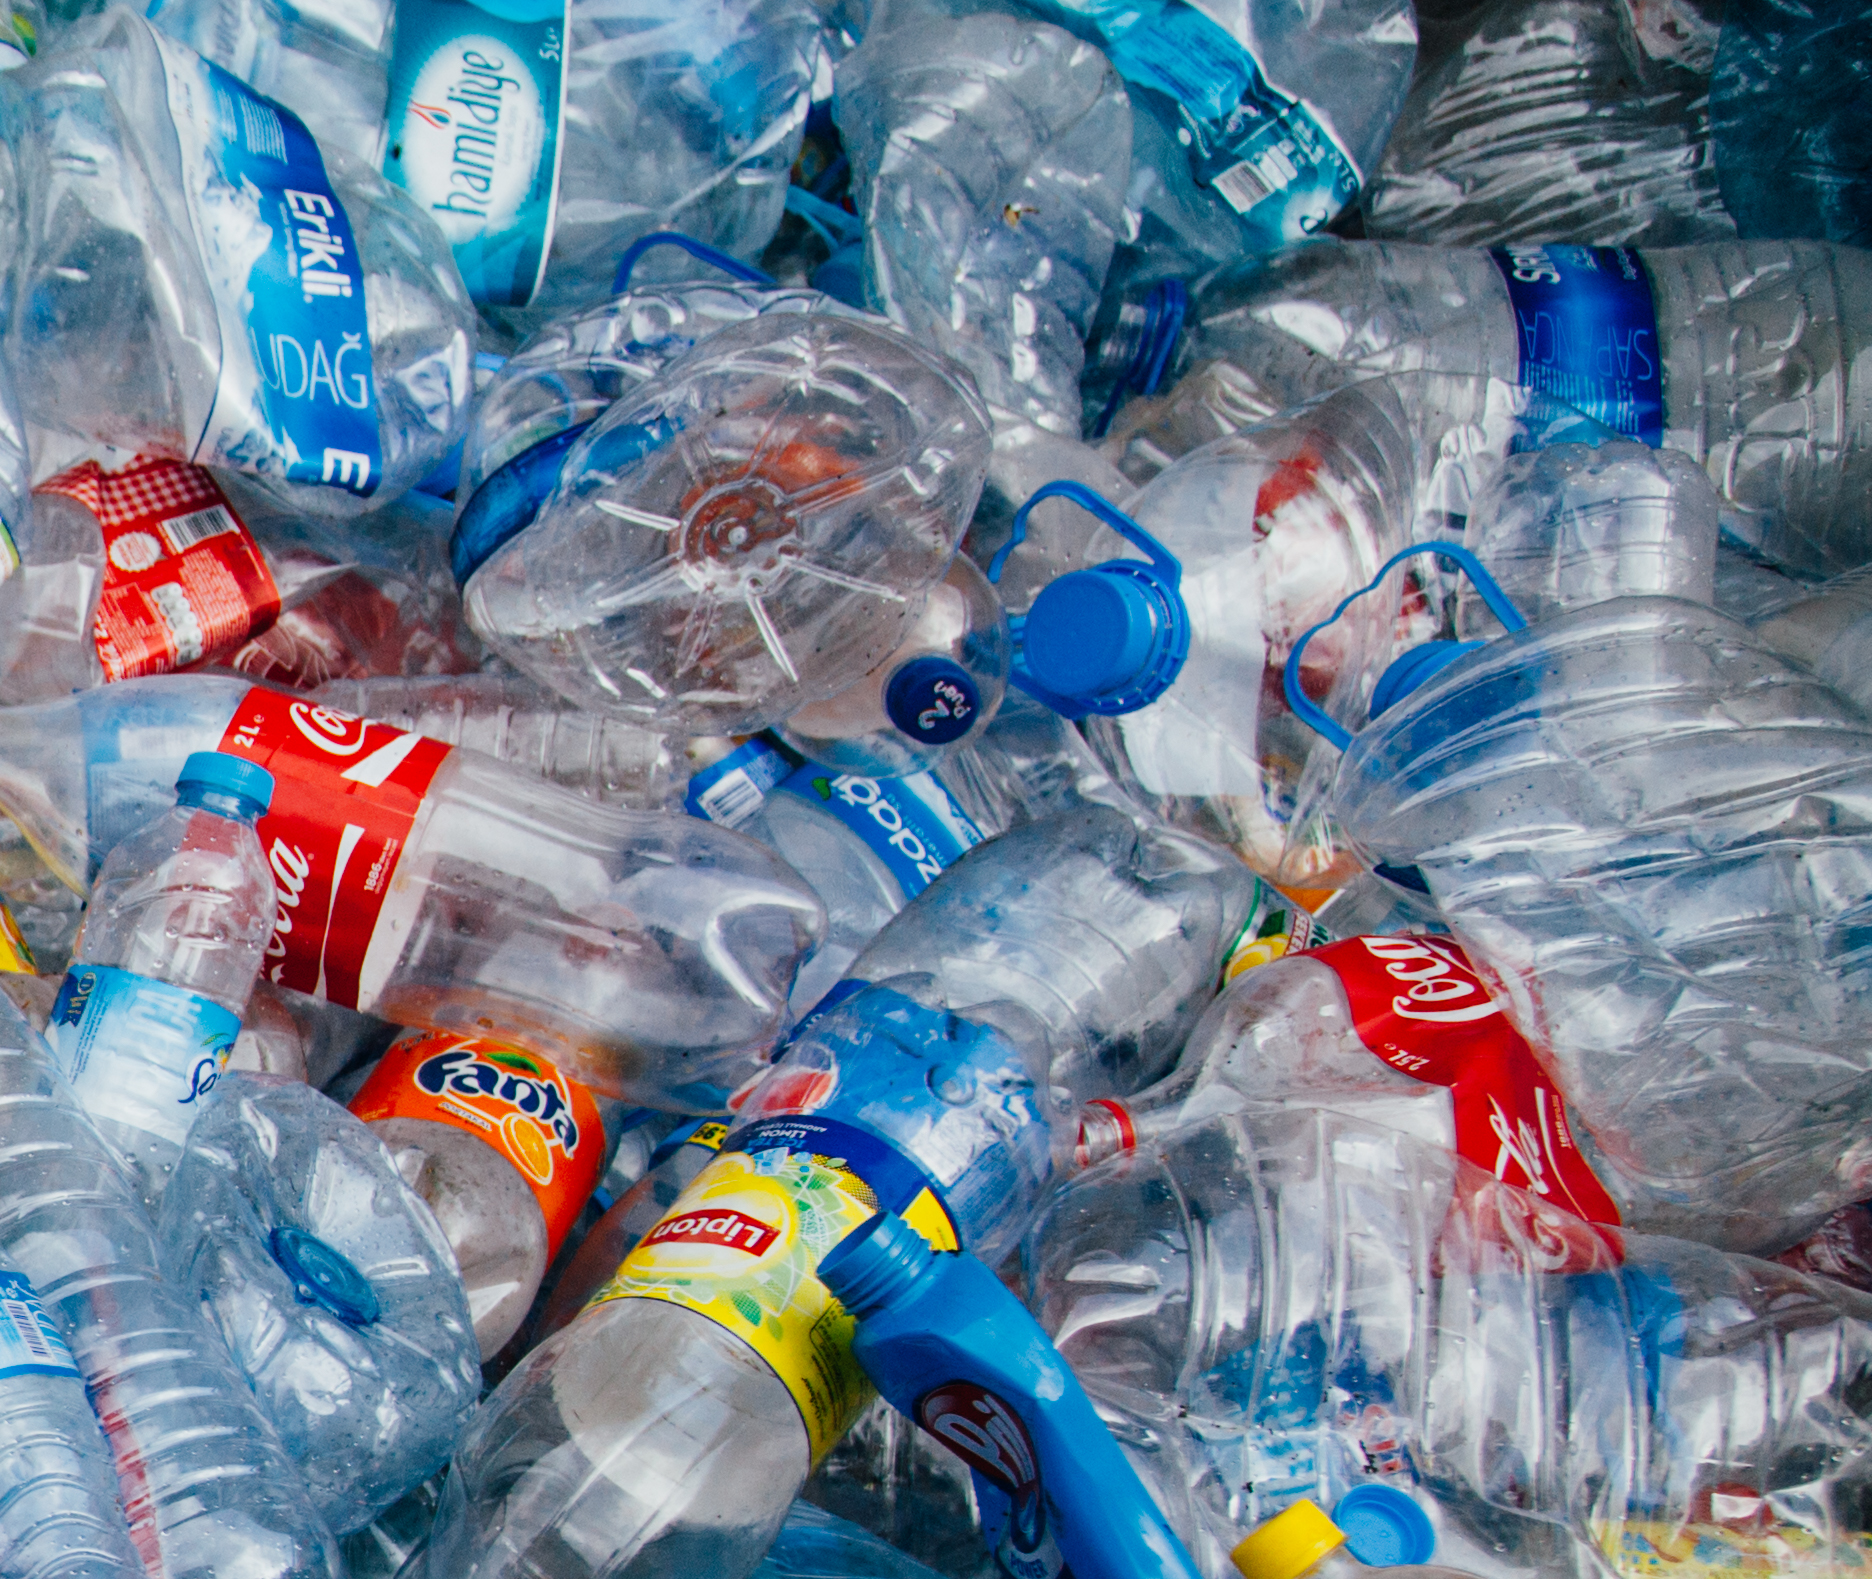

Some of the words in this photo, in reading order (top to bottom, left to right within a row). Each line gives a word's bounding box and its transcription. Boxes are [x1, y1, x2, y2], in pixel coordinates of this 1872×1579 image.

[438, 48, 520, 219] hamidiye
[282, 188, 352, 298] Erikli
[830, 775, 945, 886] zdağı
[414, 1050, 579, 1160] Fanta
[654, 1214, 768, 1250] Lipton
